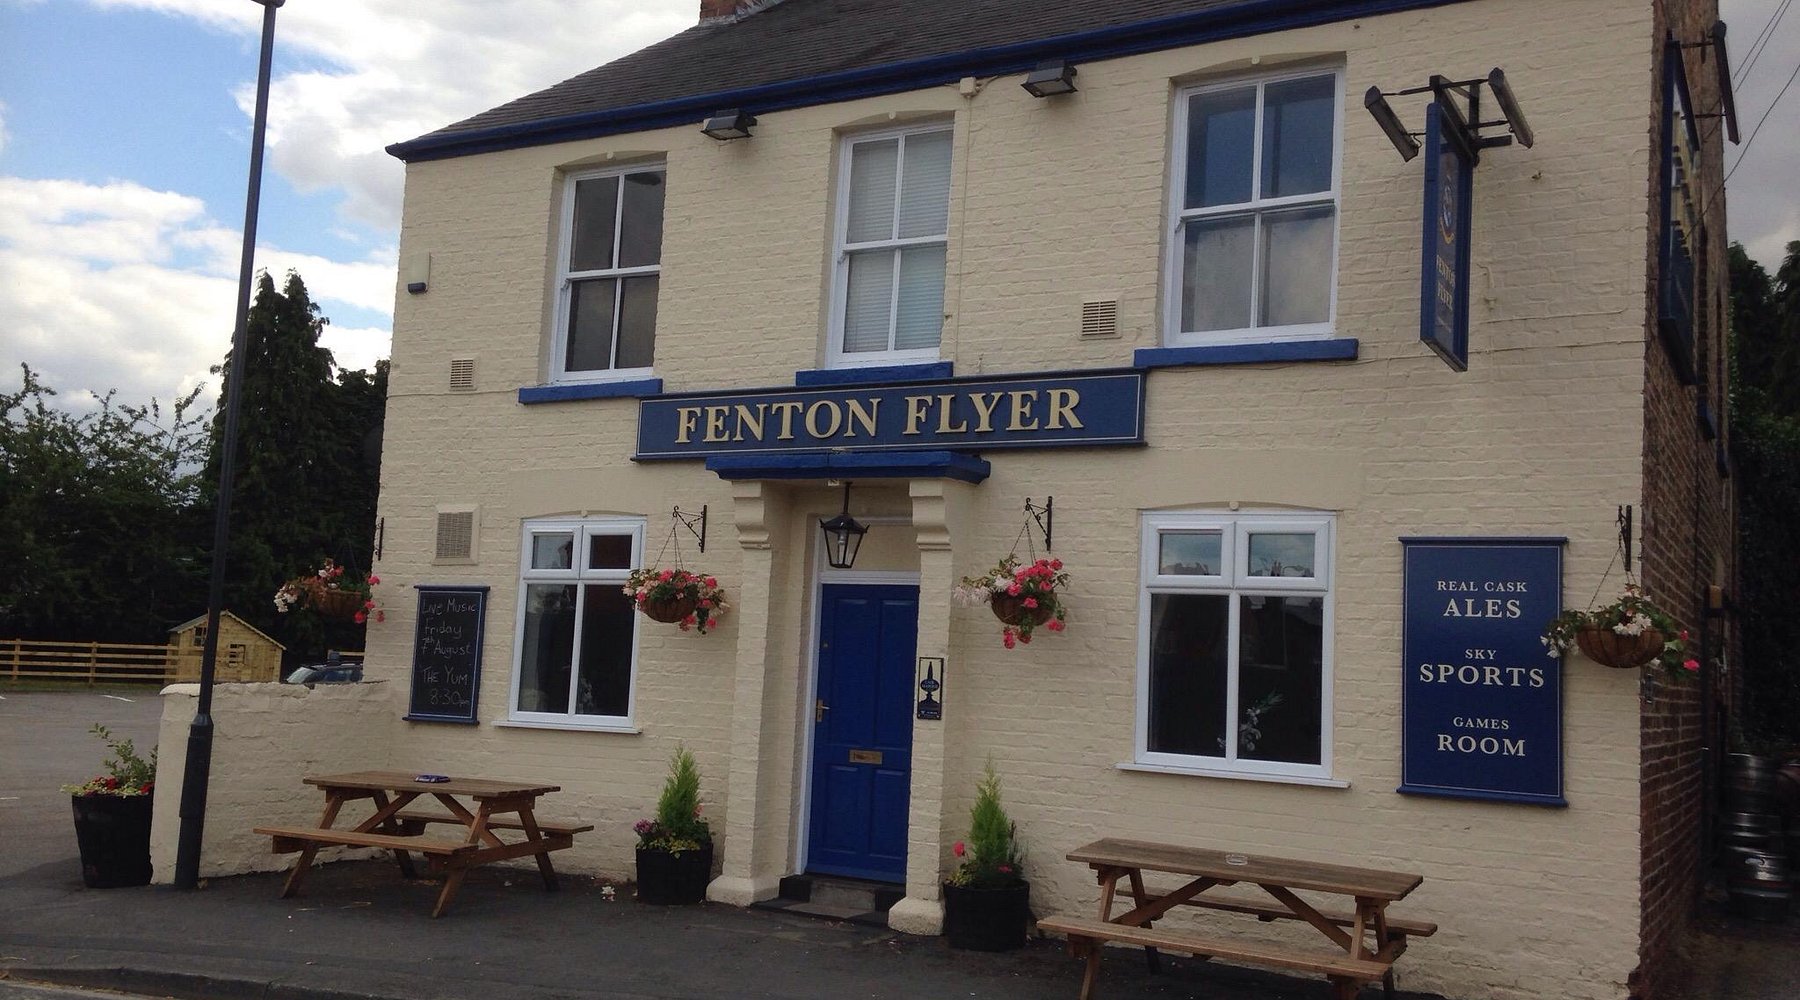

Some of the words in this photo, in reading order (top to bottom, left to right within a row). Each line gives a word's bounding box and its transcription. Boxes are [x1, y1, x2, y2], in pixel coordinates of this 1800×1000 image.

[674, 396, 883, 445] FENTON
[902, 388, 1086, 436] FLYER
[1437, 580, 1479, 592] REAL
[1484, 581, 1528, 593] CASK
[1443, 598, 1522, 619] ALES
[424, 617, 463, 640] Friday
[433, 639, 472, 660] August
[1465, 649, 1497, 661] SKY
[1419, 663, 1545, 688] SPORTS
[1453, 716, 1510, 730] GAMES
[1437, 734, 1526, 757] ROOM
